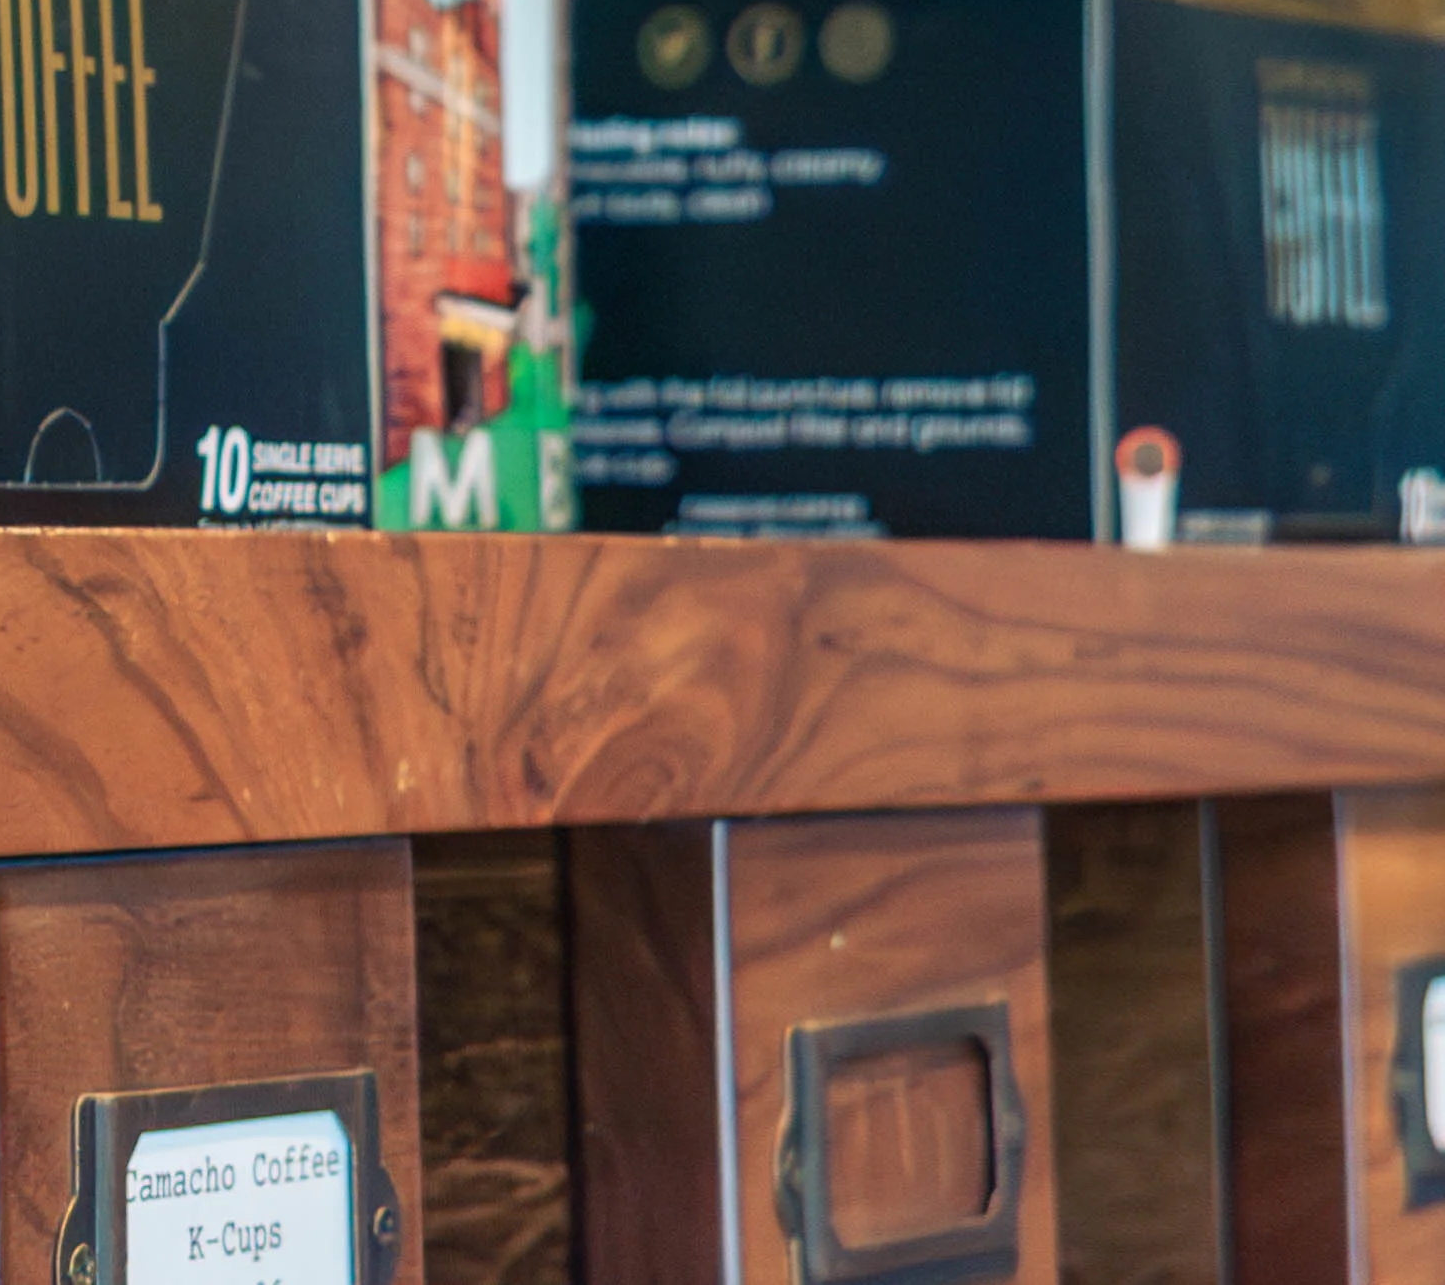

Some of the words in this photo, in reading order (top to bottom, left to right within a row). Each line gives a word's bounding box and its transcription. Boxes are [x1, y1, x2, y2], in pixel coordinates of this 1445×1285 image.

[196, 424, 250, 514] 10
[248, 481, 317, 513] COFFEE
[126, 1156, 235, 1203] Camacho
[253, 1145, 340, 1187] Coffee
[189, 1221, 282, 1261] K-Cups
